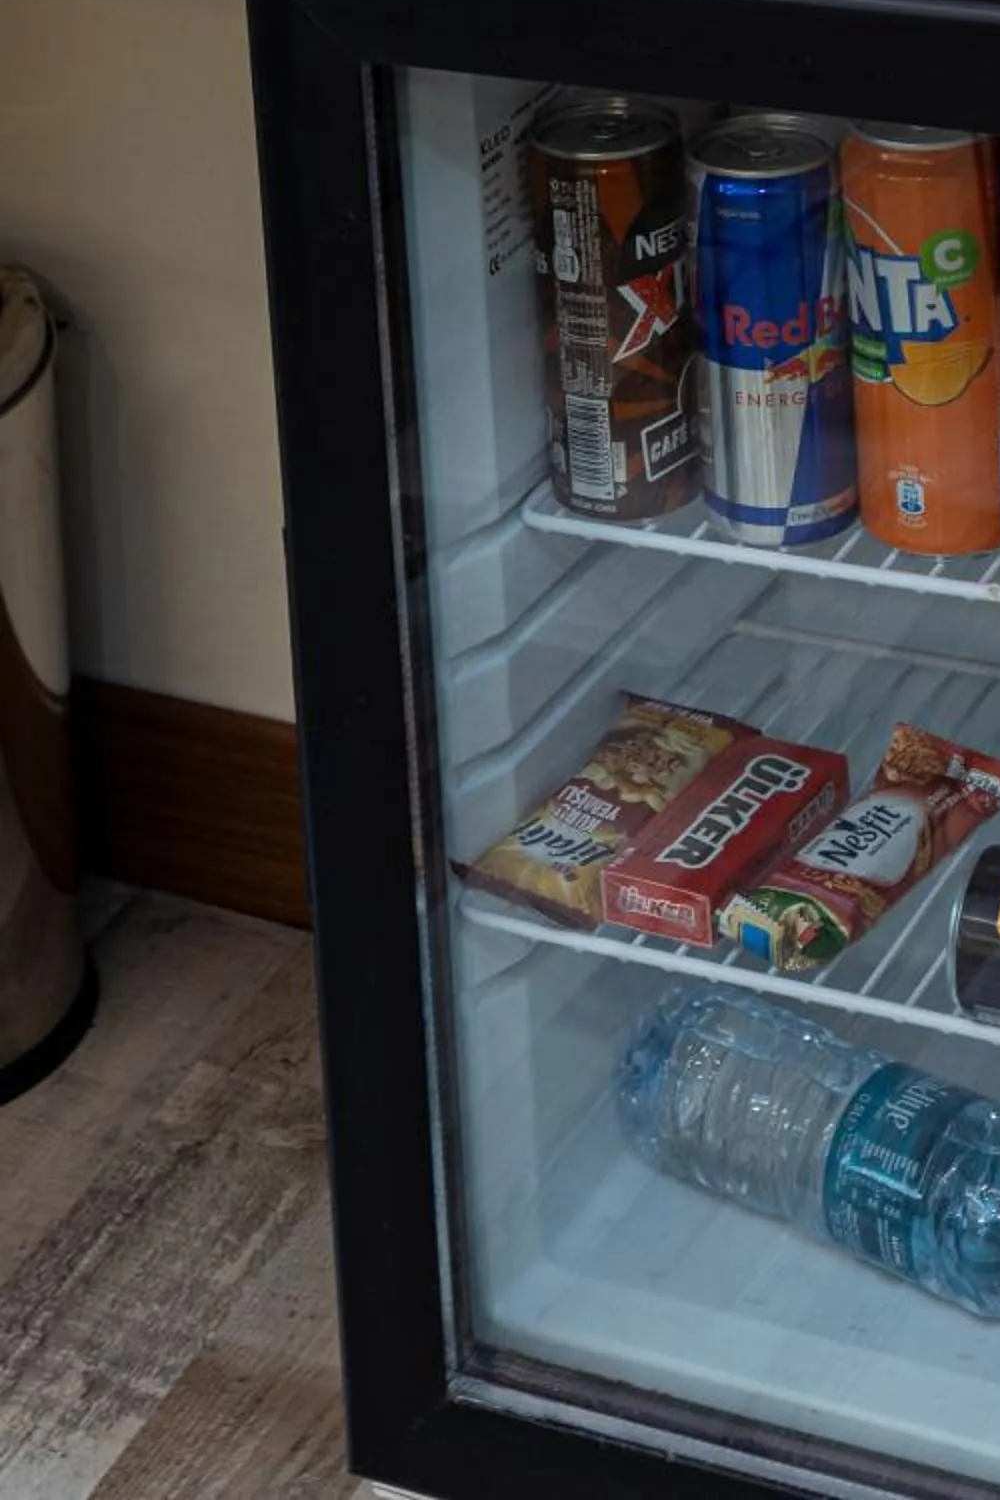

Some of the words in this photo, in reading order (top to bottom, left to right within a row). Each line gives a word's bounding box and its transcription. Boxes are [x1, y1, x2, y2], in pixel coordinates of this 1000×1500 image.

[723, 302, 810, 348] Red
[735, 391, 812, 408] ENERG
[657, 752, 812, 869] ÜLKER
[818, 804, 902, 867] Nesfit
